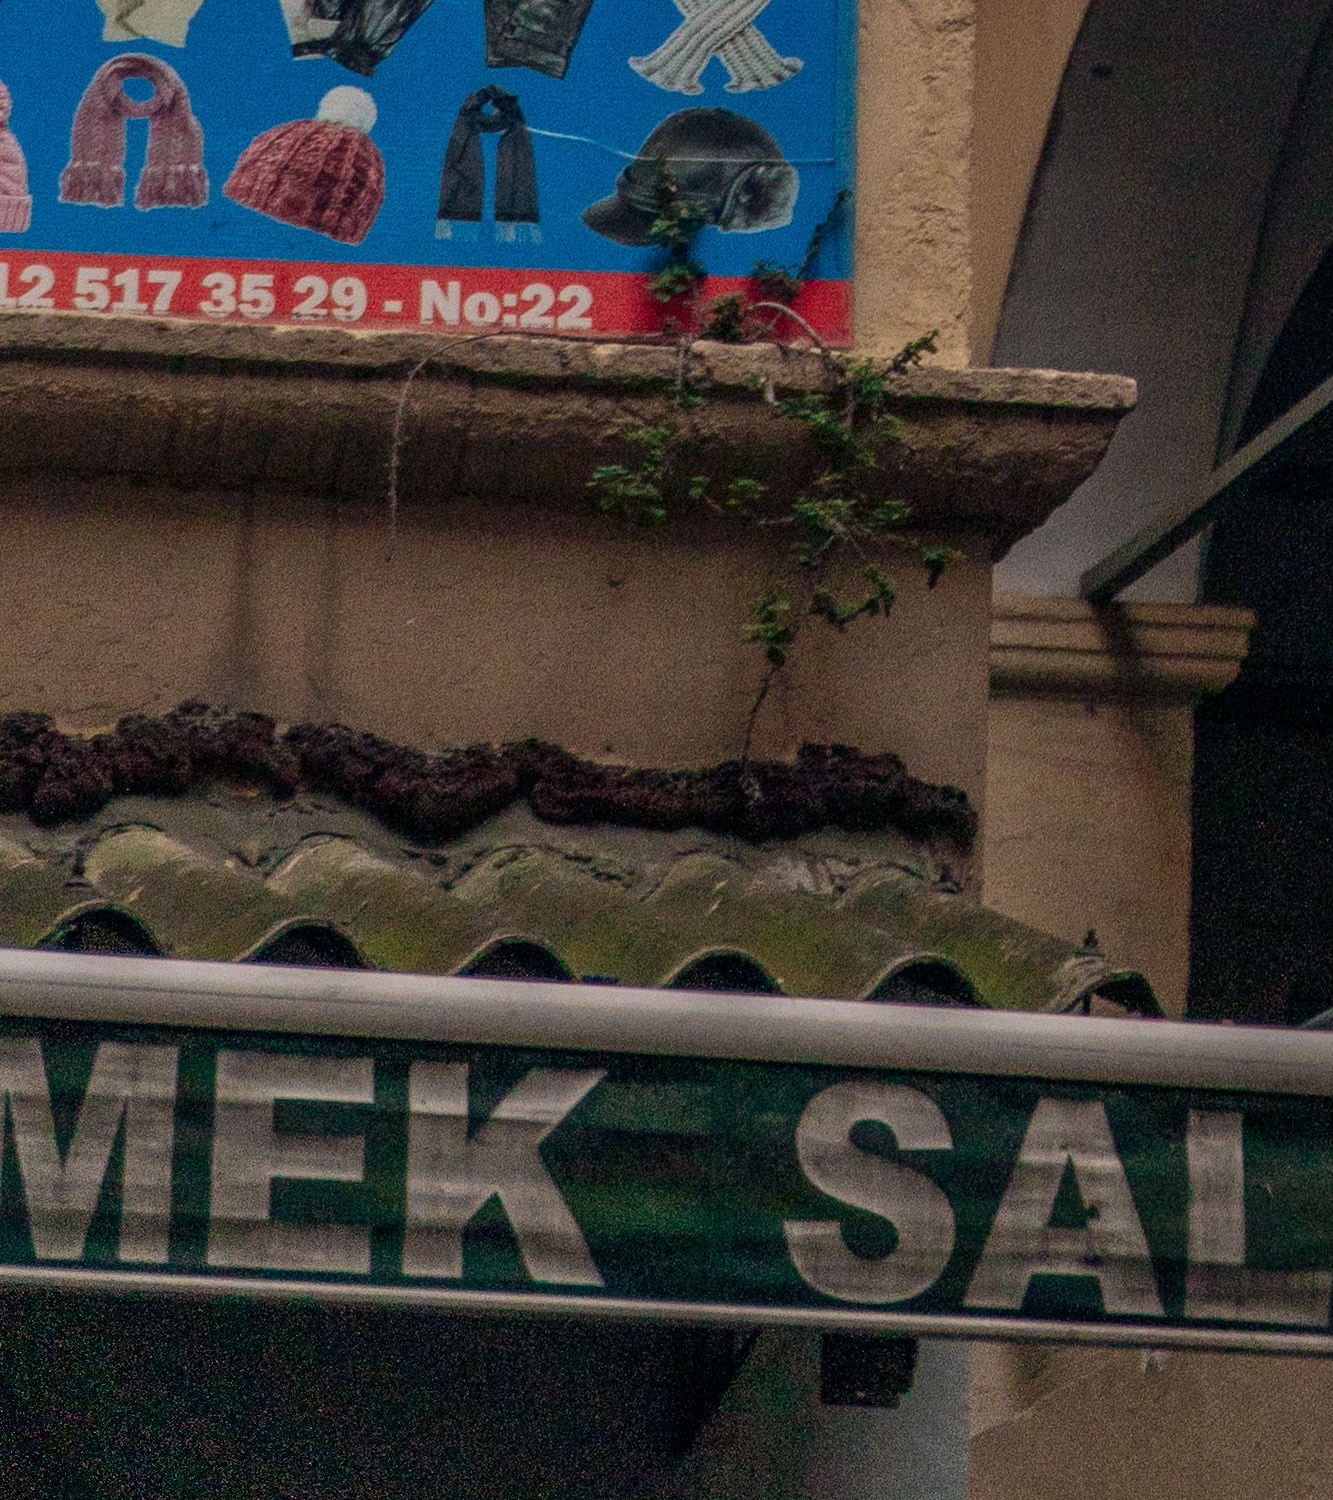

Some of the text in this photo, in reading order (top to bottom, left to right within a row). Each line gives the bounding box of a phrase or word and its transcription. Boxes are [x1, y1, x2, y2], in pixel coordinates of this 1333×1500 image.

[73, 267, 182, 315] 517
[201, 272, 275, 317] 35
[292, 276, 366, 321] 29
[420, 280, 594, 329] No:22
[0, 1037, 608, 1287] MEK
